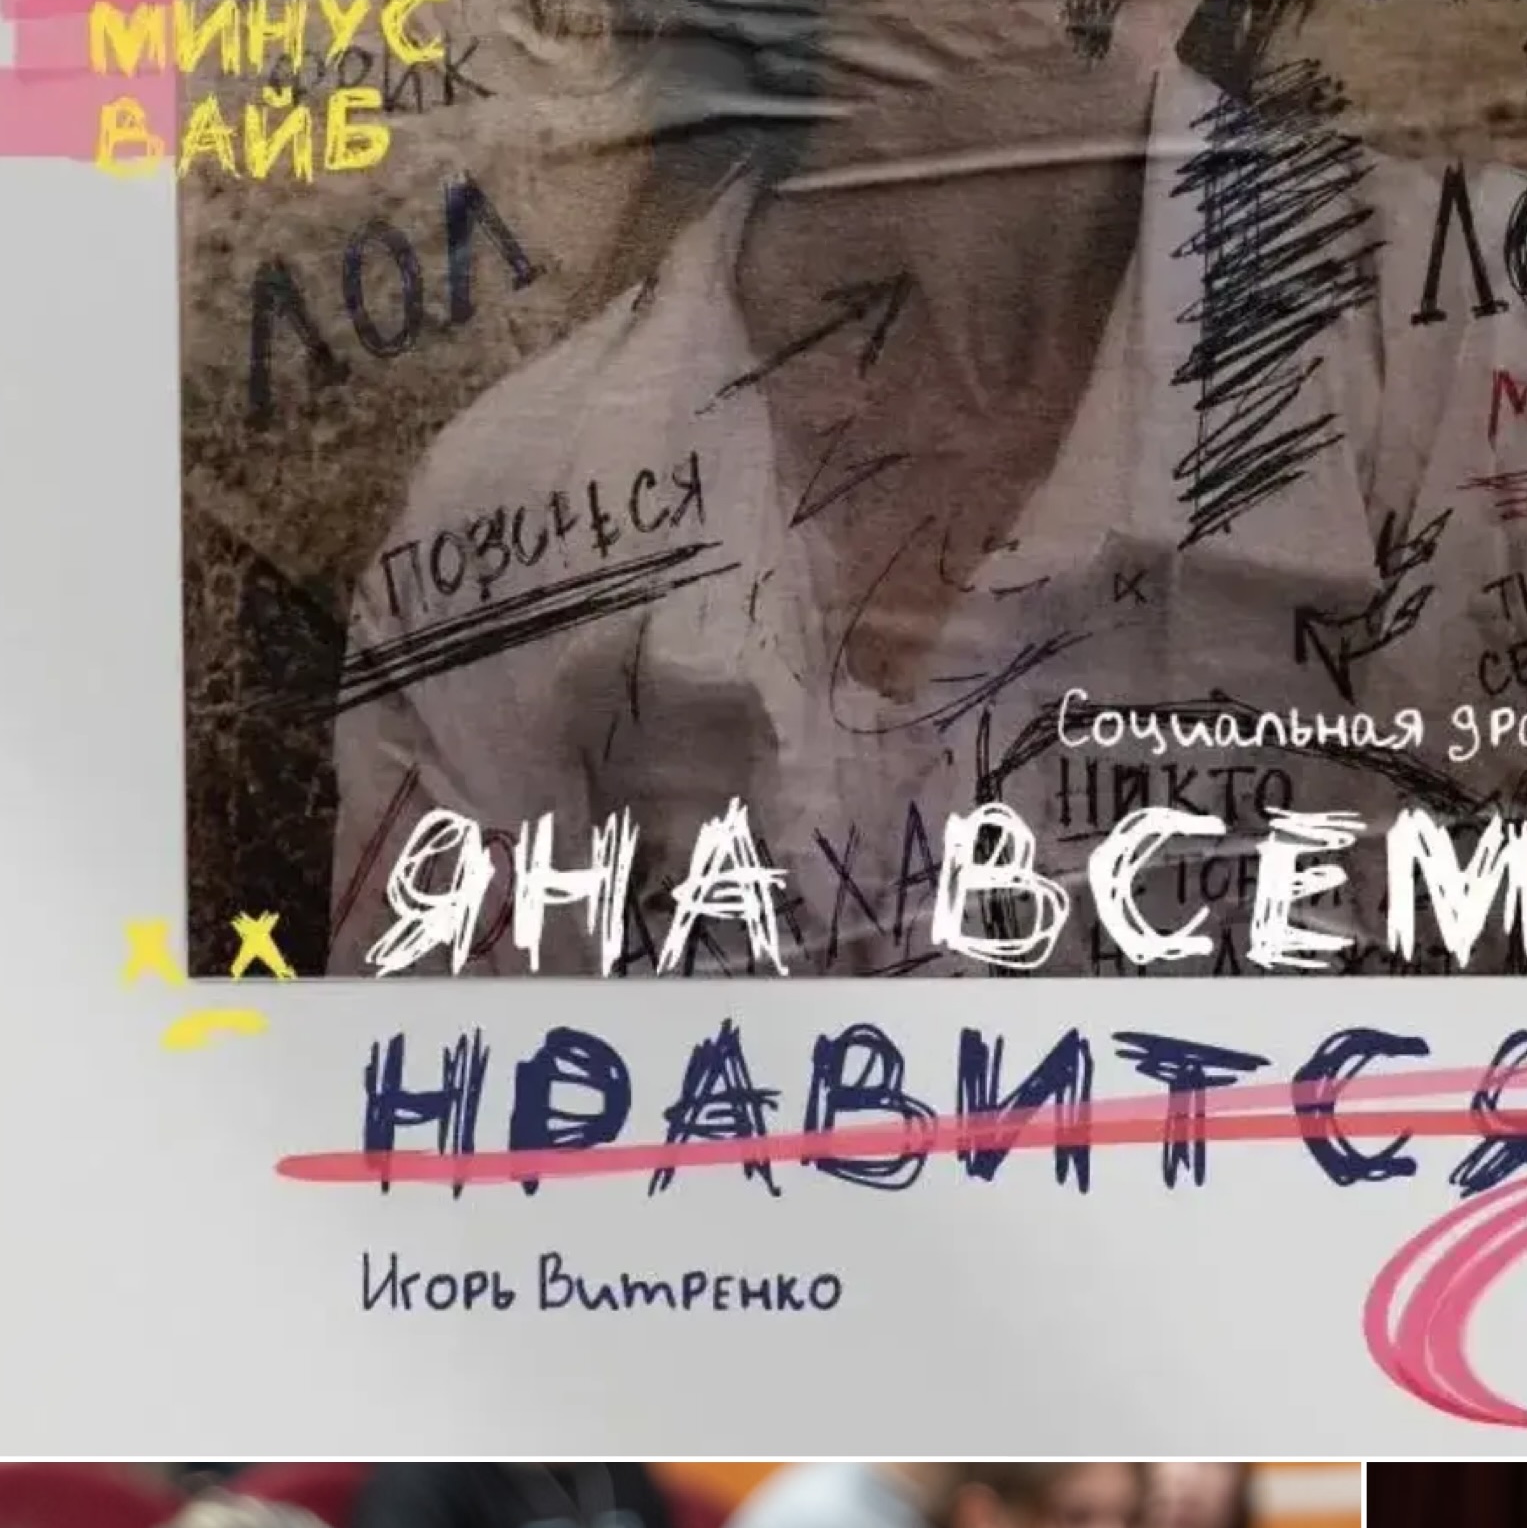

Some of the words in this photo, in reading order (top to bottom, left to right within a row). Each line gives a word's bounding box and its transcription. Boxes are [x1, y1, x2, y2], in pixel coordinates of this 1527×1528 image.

[96, 87, 391, 183] ВАЙБ
[246, 169, 547, 429] ЛОЛ
[1057, 687, 1425, 761] Социальная
[366, 797, 790, 976] ЯНА
[360, 1250, 517, 1313] Игорь
[539, 1253, 844, 1314] Витренко
